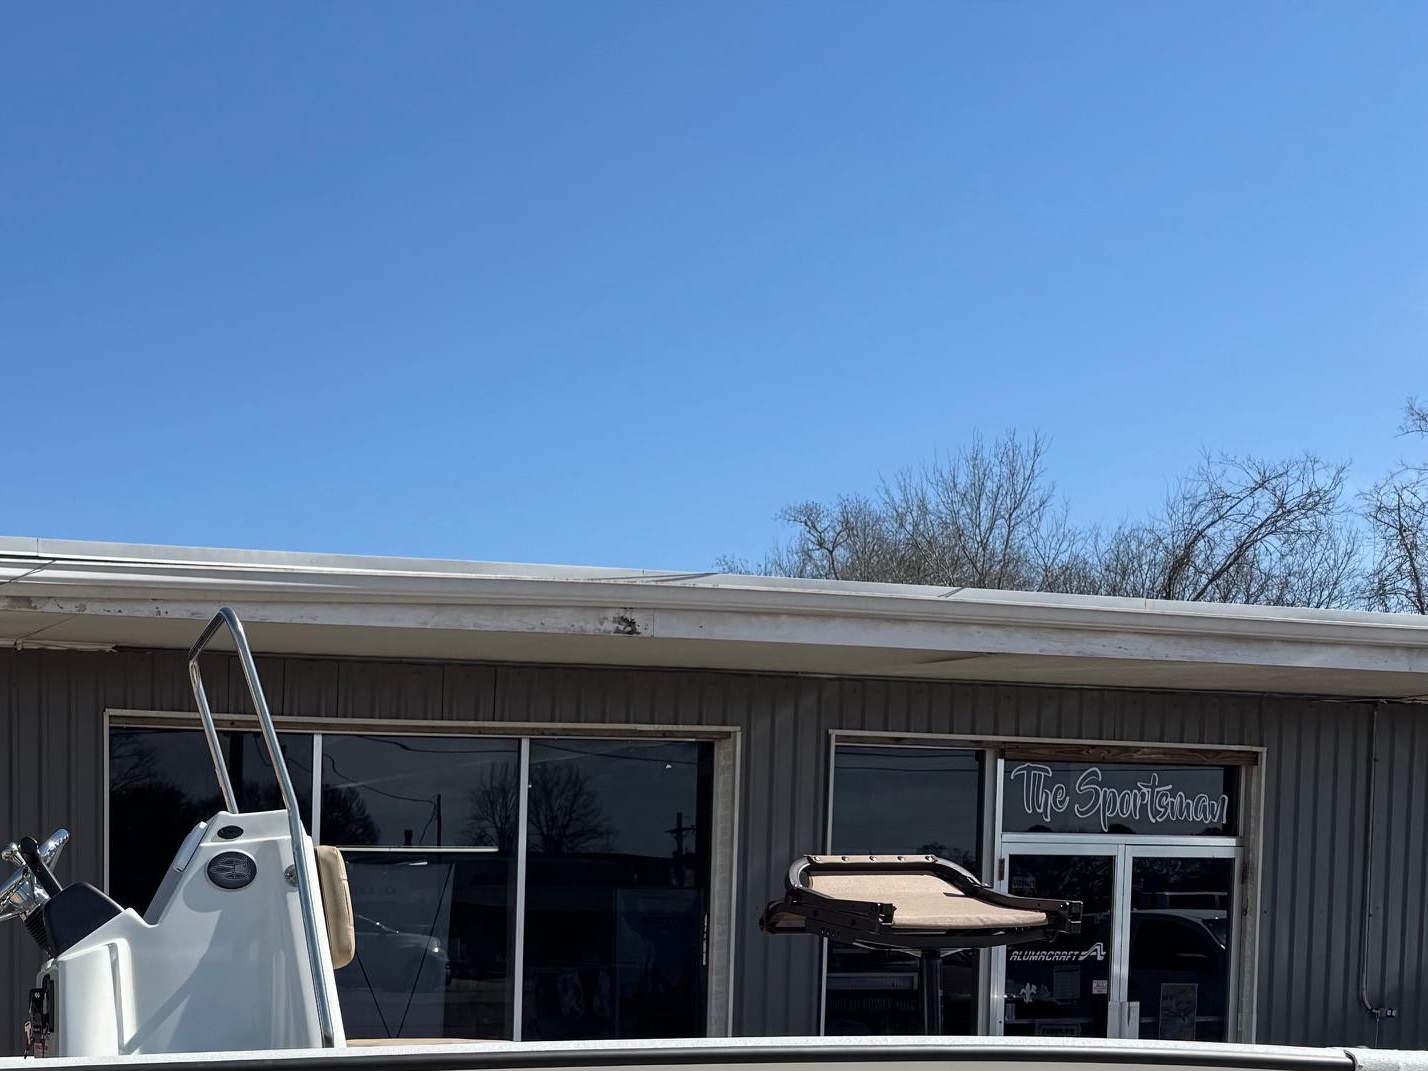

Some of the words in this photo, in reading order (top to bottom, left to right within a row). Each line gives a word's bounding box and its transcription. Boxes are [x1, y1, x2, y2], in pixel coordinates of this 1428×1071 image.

[1011, 763, 1070, 822] The
[1075, 767, 1228, 832] Sportsman
[1009, 950, 1079, 961] ALUMACRAFT
